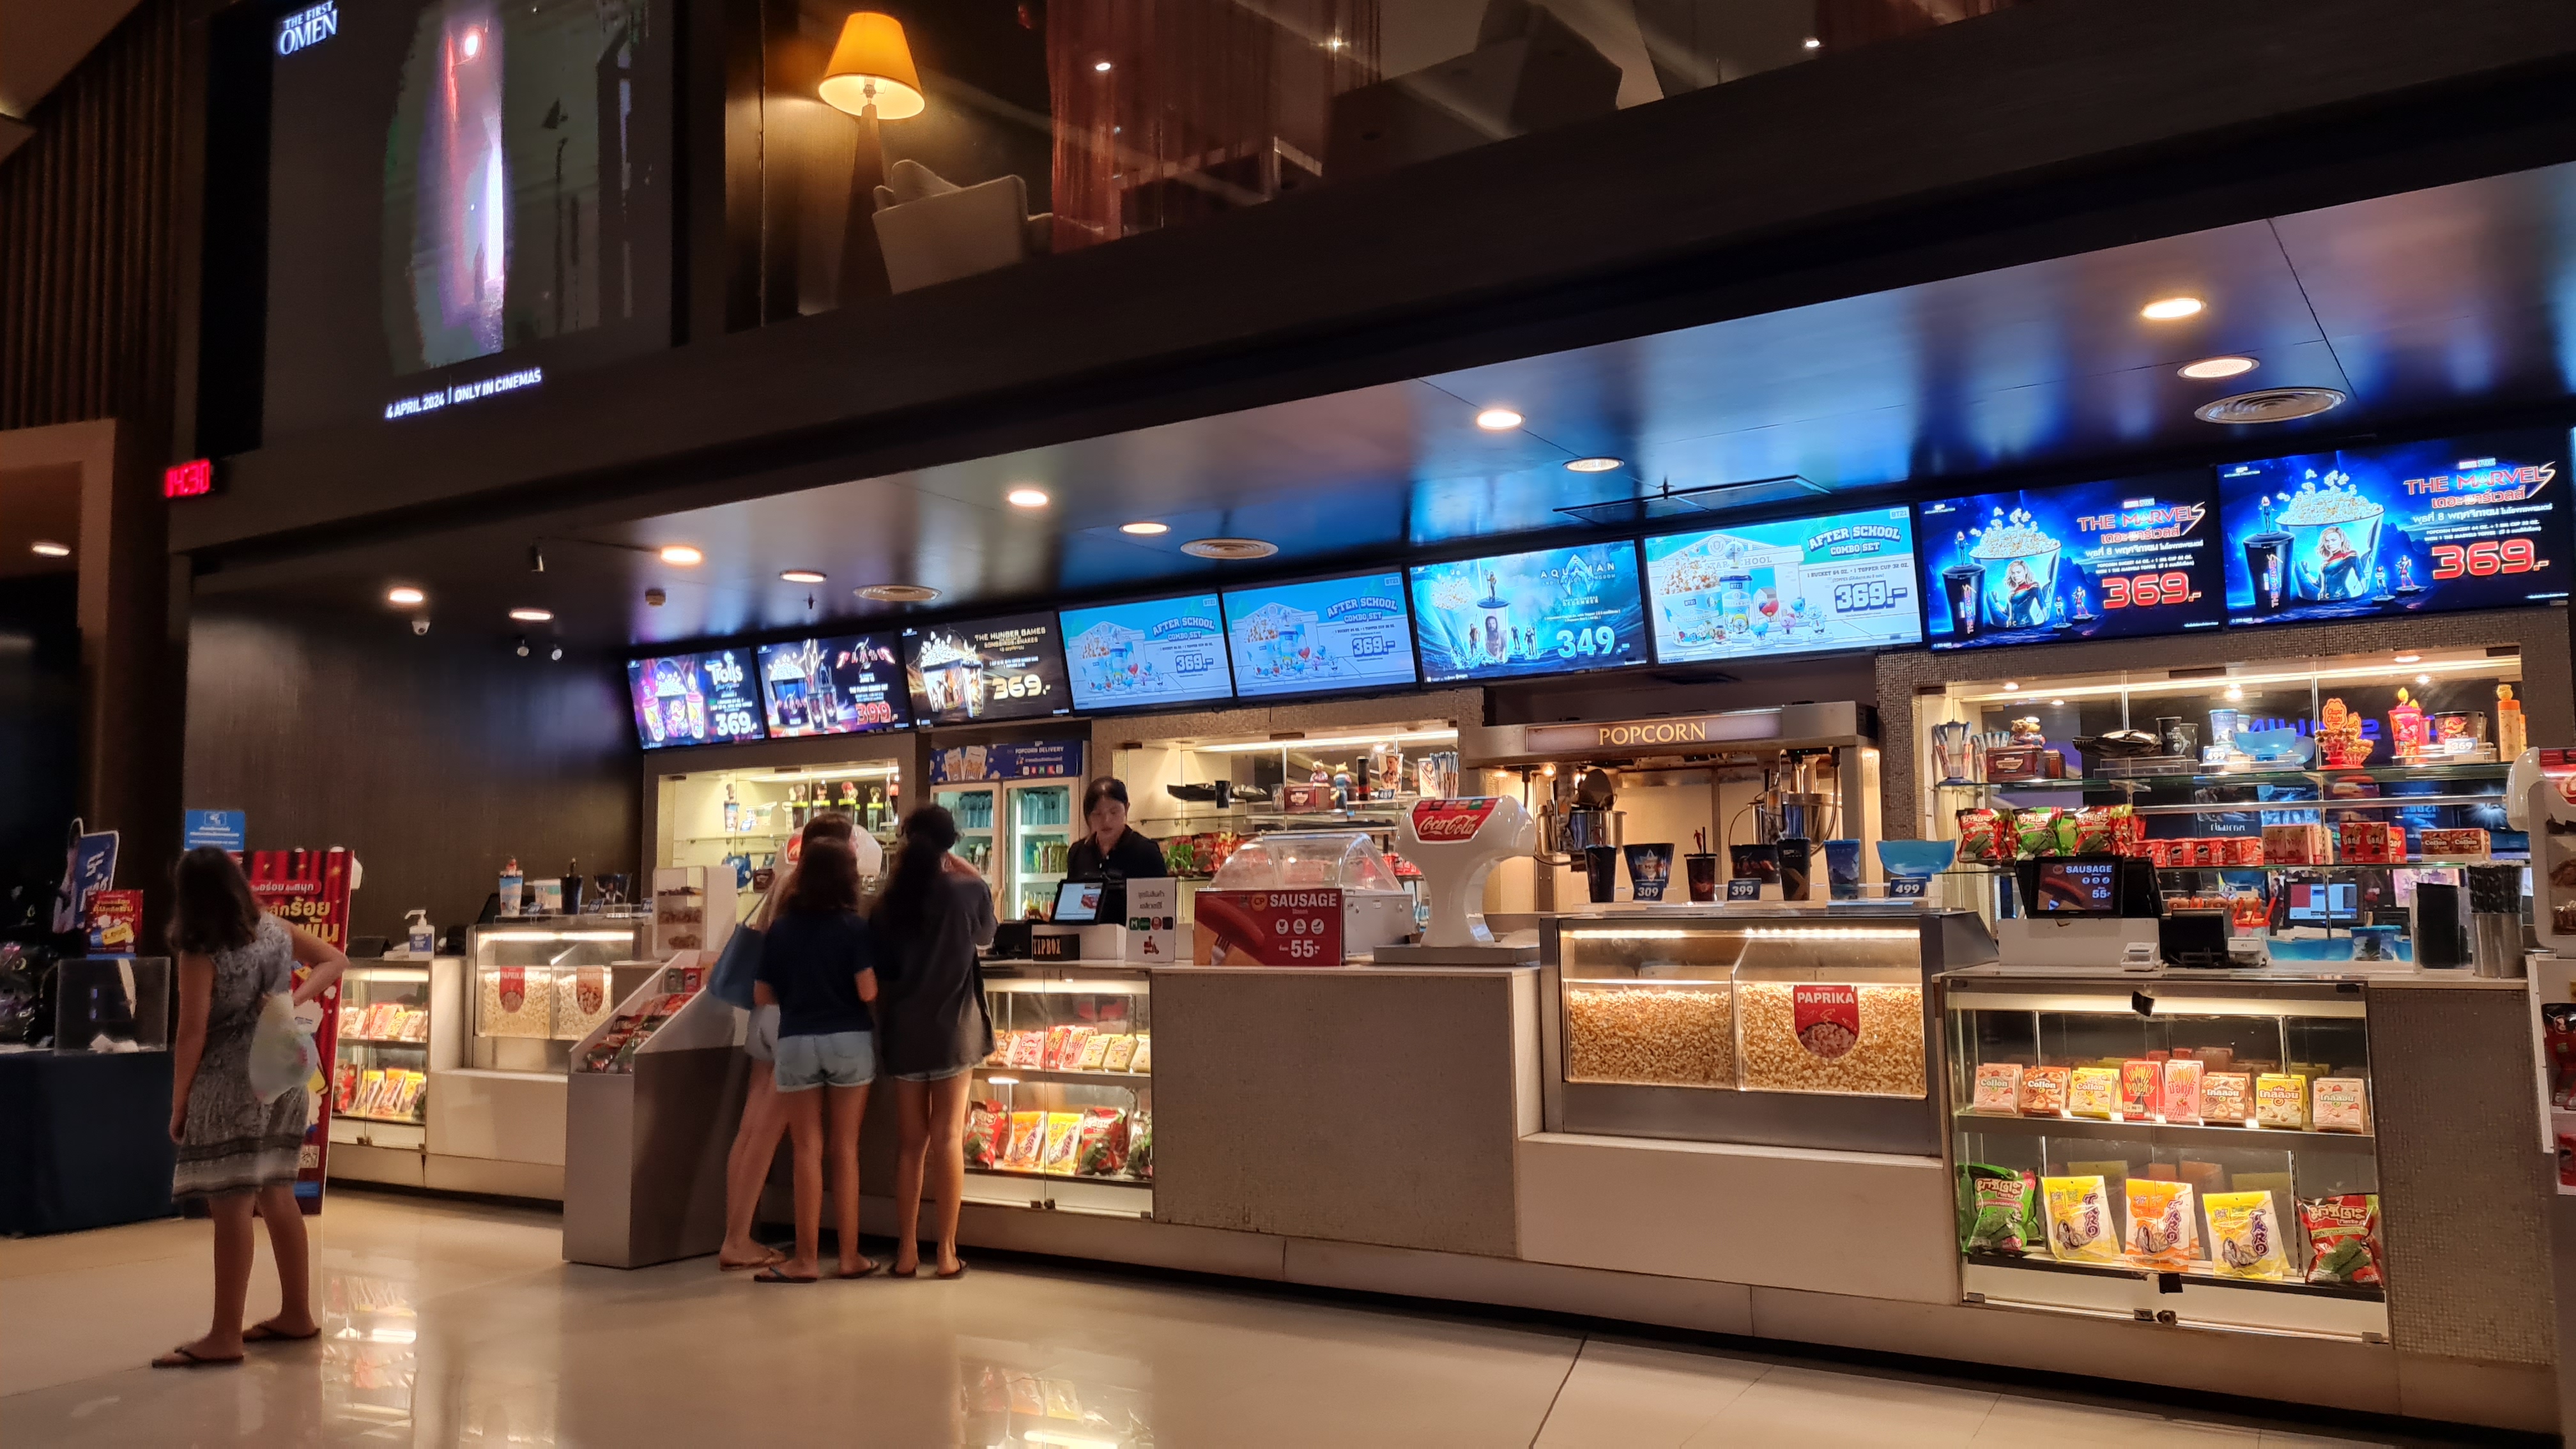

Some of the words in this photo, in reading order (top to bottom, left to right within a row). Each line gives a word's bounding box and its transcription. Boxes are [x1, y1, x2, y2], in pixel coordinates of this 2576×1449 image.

[283, 14, 303, 29] THE
[306, 1, 333, 20] FIRST
[280, 9, 337, 55] OMEN
[386, 404, 394, 419] 4
[394, 399, 422, 417] APRIL
[422, 392, 445, 411] 2024
[454, 383, 480, 402] ONLY
[482, 380, 493, 396] IN
[495, 368, 542, 392] CINEMAS
[2404, 476, 2449, 495] THE
[2457, 461, 2556, 499] MARVELS
[2076, 514, 2115, 532] THE
[2122, 501, 2205, 536] MARVELS
[2437, 512, 2444, 521] 8
[1808, 527, 1850, 551] AFTER
[1853, 525, 1901, 541] SCHOOL
[1830, 544, 1860, 555] COMBO
[1862, 542, 1880, 553] SET
[1540, 562, 1615, 579] AQUAMAN
[1834, 579, 1908, 614] 369.-
[1326, 599, 1358, 618] AFTER
[1360, 597, 1398, 611] SCHOOL
[1344, 614, 1367, 622] COMBO
[1368, 611, 1382, 620] SET
[1152, 617, 1181, 636] AFTER
[1181, 617, 1215, 631] SCHOOL
[974, 633, 988, 642] THE
[990, 630, 1019, 641] HUNGER
[1021, 627, 1046, 637] GAMES
[1167, 632, 1188, 641] COMBO
[1189, 631, 1202, 639] SET
[1352, 636, 1396, 657] 369.-
[1176, 653, 1214, 674] 369.-
[1598, 721, 1706, 746] POPCORN
[2452, 742, 2473, 751] 369
[2205, 751, 2226, 761] 499
[2066, 865, 2112, 873] SAUSAGE
[1637, 886, 1659, 897] 309
[1731, 885, 1754, 896] 399
[1895, 884, 1920, 894] 499
[1269, 893, 1337, 907] SAUSAGE
[1032, 938, 1061, 955] TIPBOX
[1797, 992, 1855, 1004] PAPRIKA
[1980, 1079, 2008, 1087] Collon
[2027, 1080, 2056, 1089] Collon
[2076, 1083, 2105, 1091] Collon
[2249, 1208, 2269, 1256] TARO
